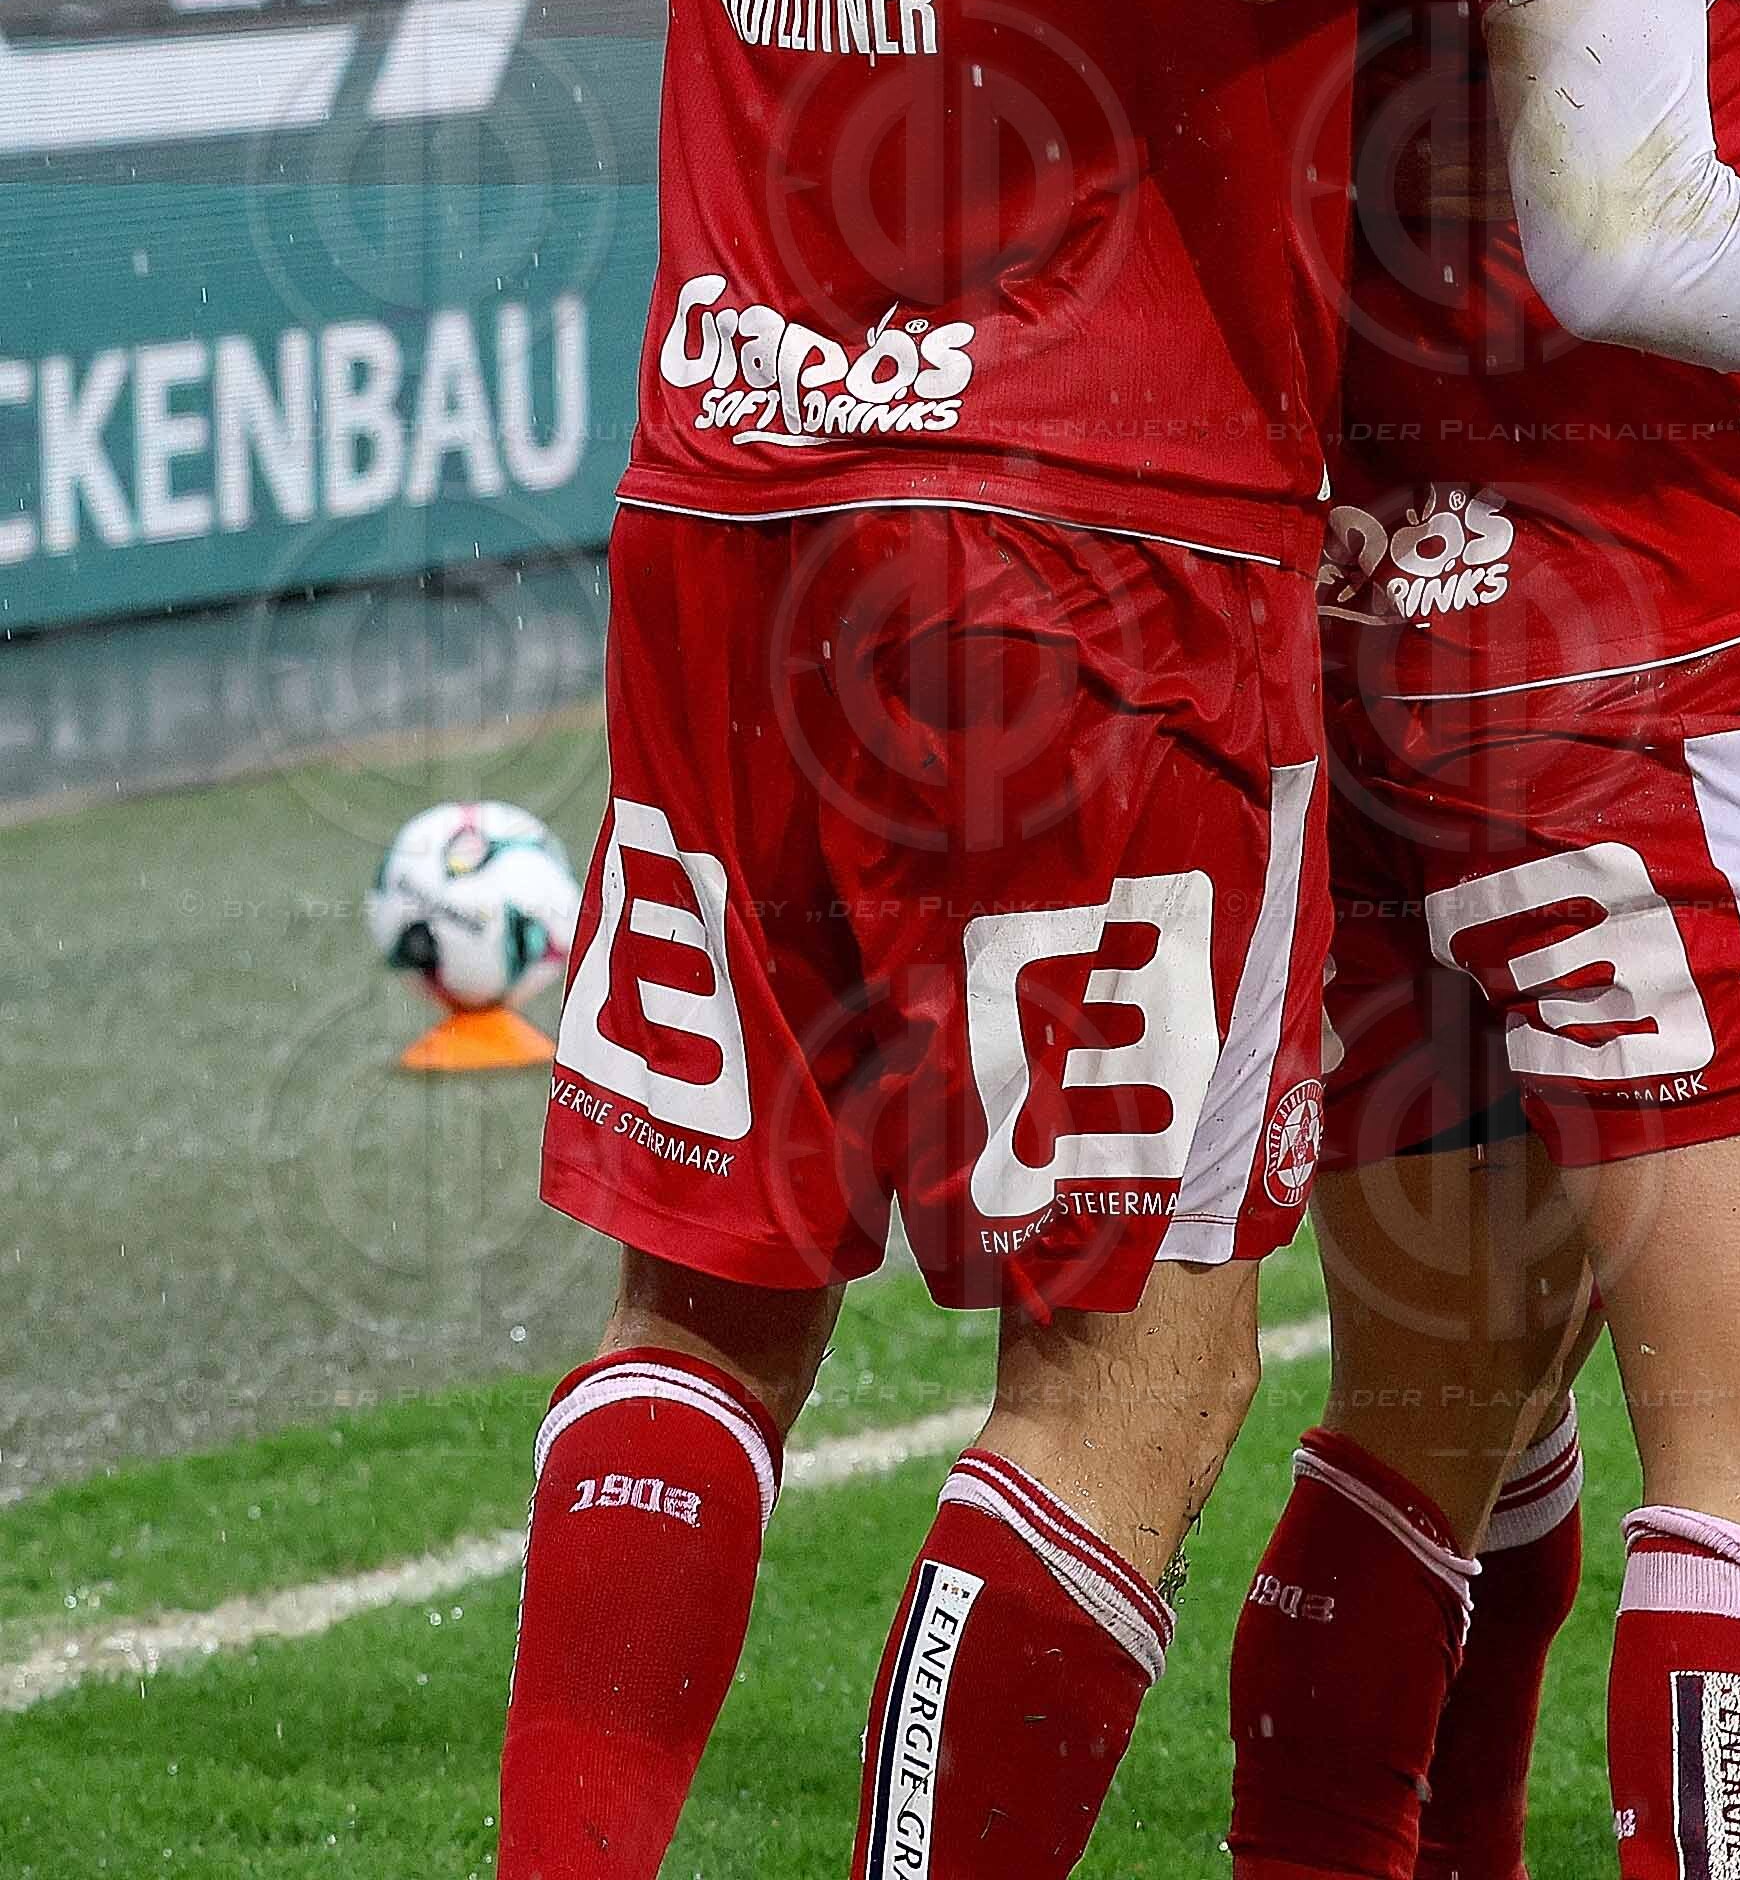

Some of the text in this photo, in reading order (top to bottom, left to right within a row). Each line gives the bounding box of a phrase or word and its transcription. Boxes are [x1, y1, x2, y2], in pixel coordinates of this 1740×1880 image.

[802, 389, 964, 434] DRINKS
[551, 1076, 615, 1125] NERGIE
[1055, 1191, 1179, 1216] STEIERMA
[568, 1473, 701, 1528] 1902
[899, 1605, 959, 1796] ENERGIE
